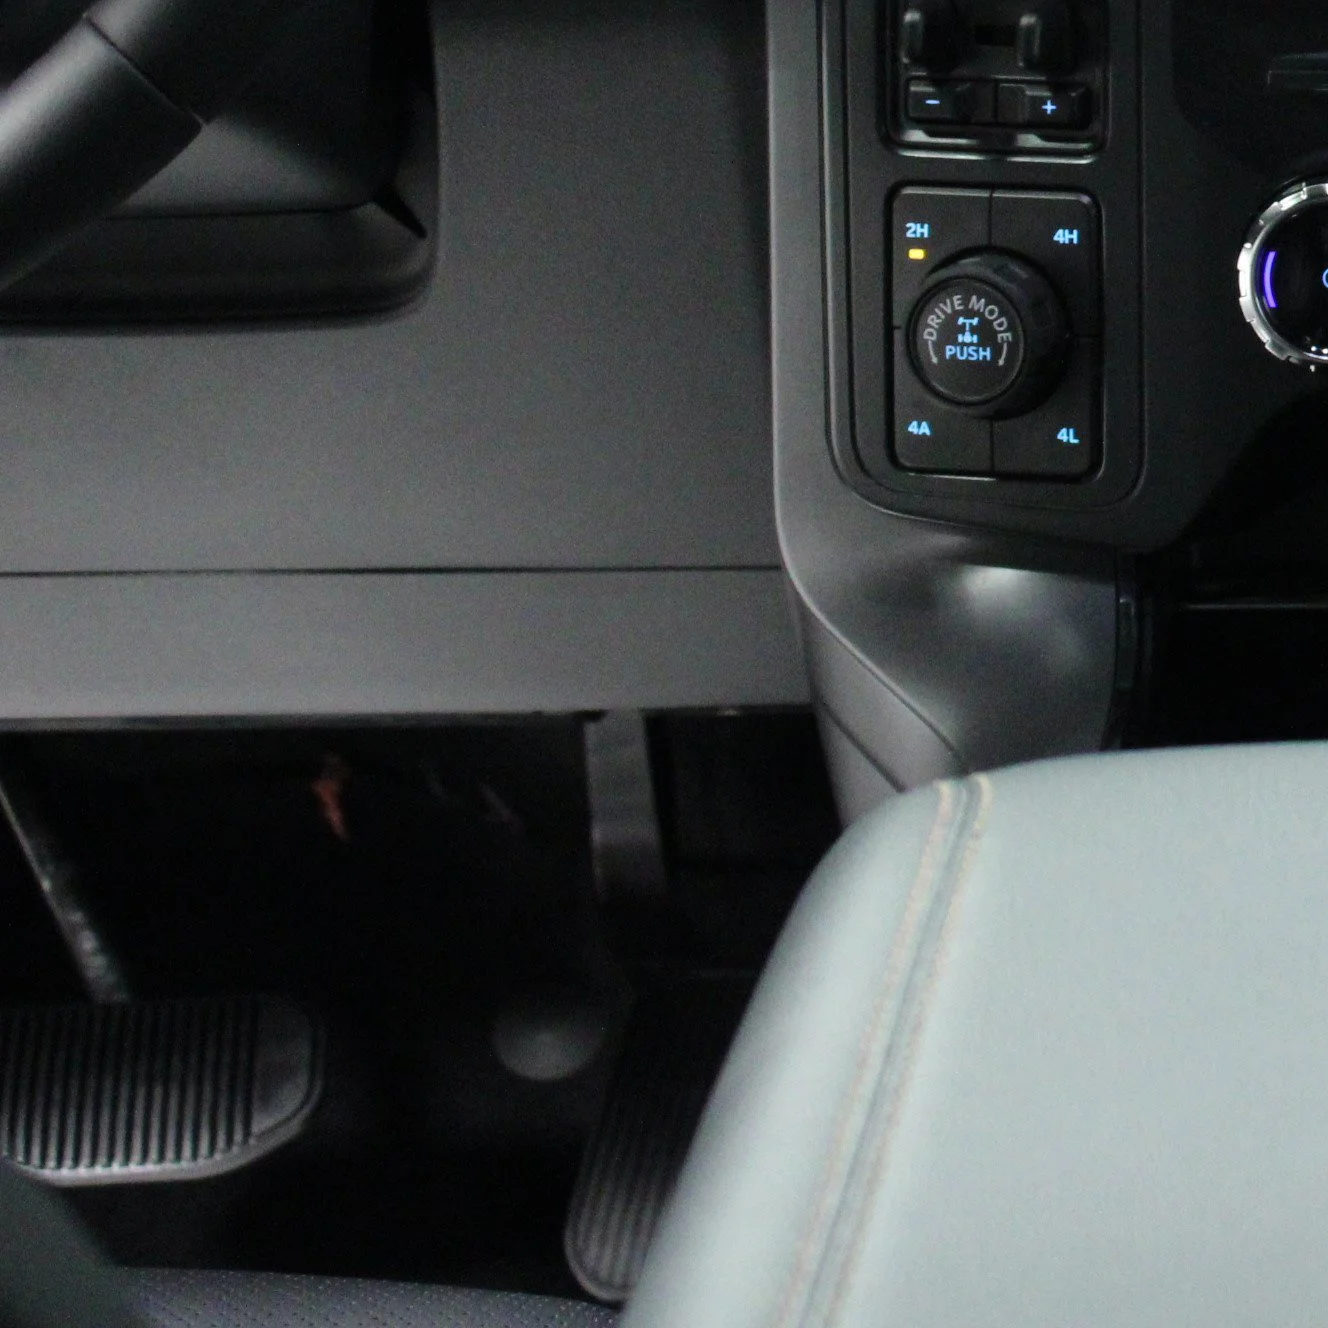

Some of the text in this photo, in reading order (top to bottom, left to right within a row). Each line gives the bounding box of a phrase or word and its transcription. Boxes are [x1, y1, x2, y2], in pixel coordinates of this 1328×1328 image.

[905, 222, 929, 239] 2H
[1052, 228, 1079, 245] 4H
[923, 295, 1012, 343] DRIVE MODE
[945, 344, 991, 361] PUSH
[907, 420, 931, 436] 4A
[1056, 427, 1080, 444] 4L
